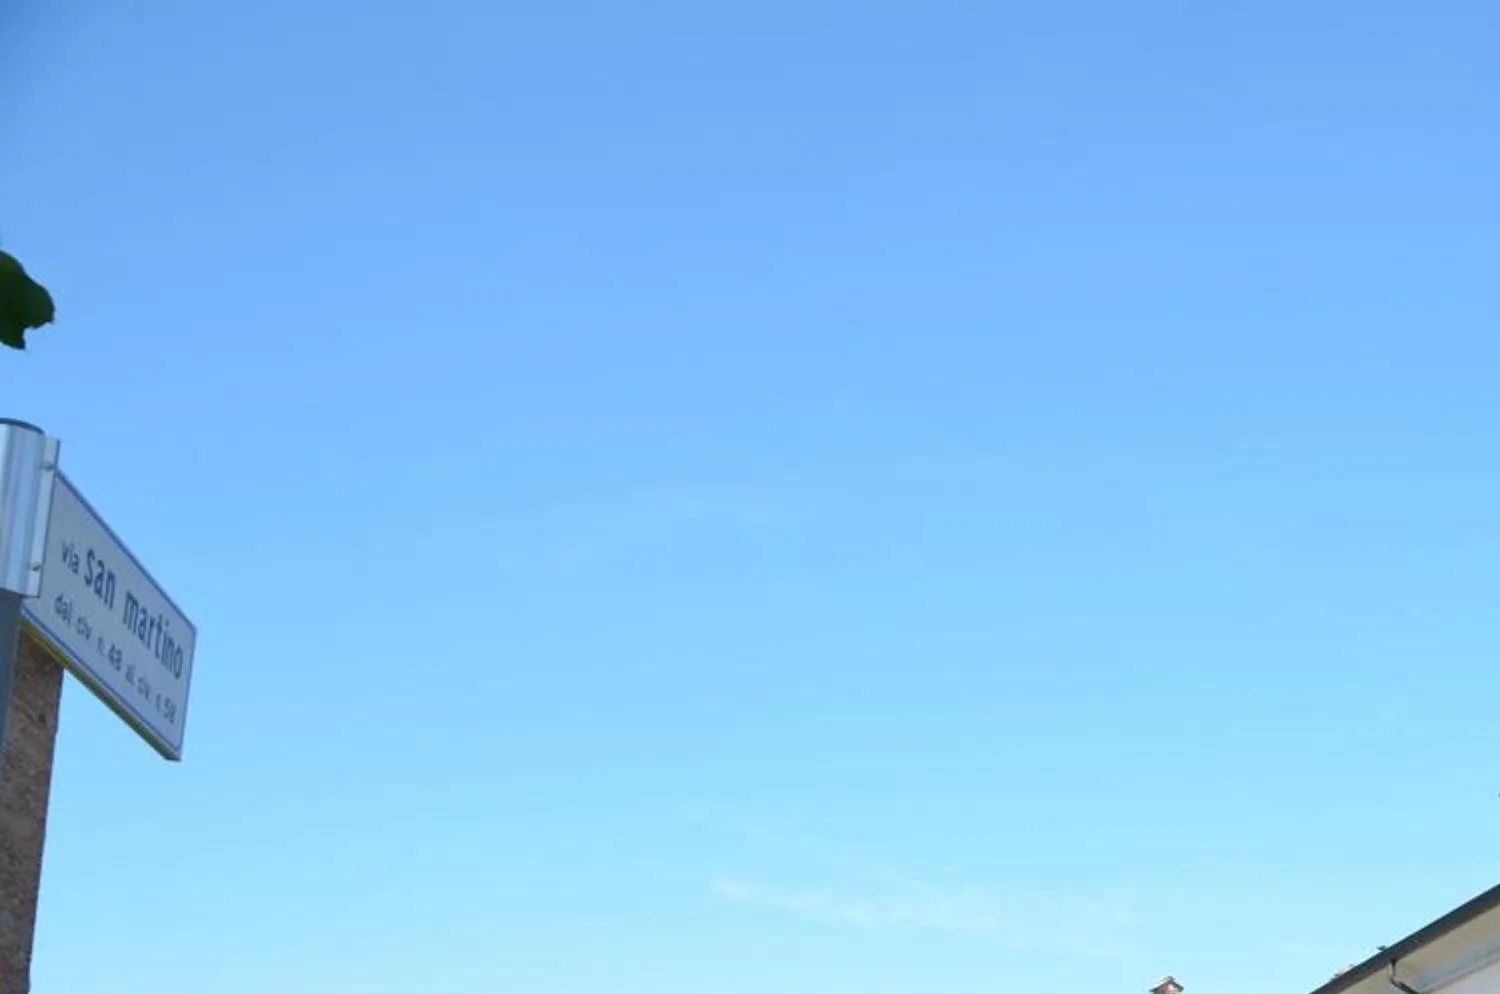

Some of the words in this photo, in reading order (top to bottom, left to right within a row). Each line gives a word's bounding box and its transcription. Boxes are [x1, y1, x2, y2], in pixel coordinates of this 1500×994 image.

[61, 542, 80, 574] via
[84, 549, 115, 609] san
[123, 591, 183, 680] martino
